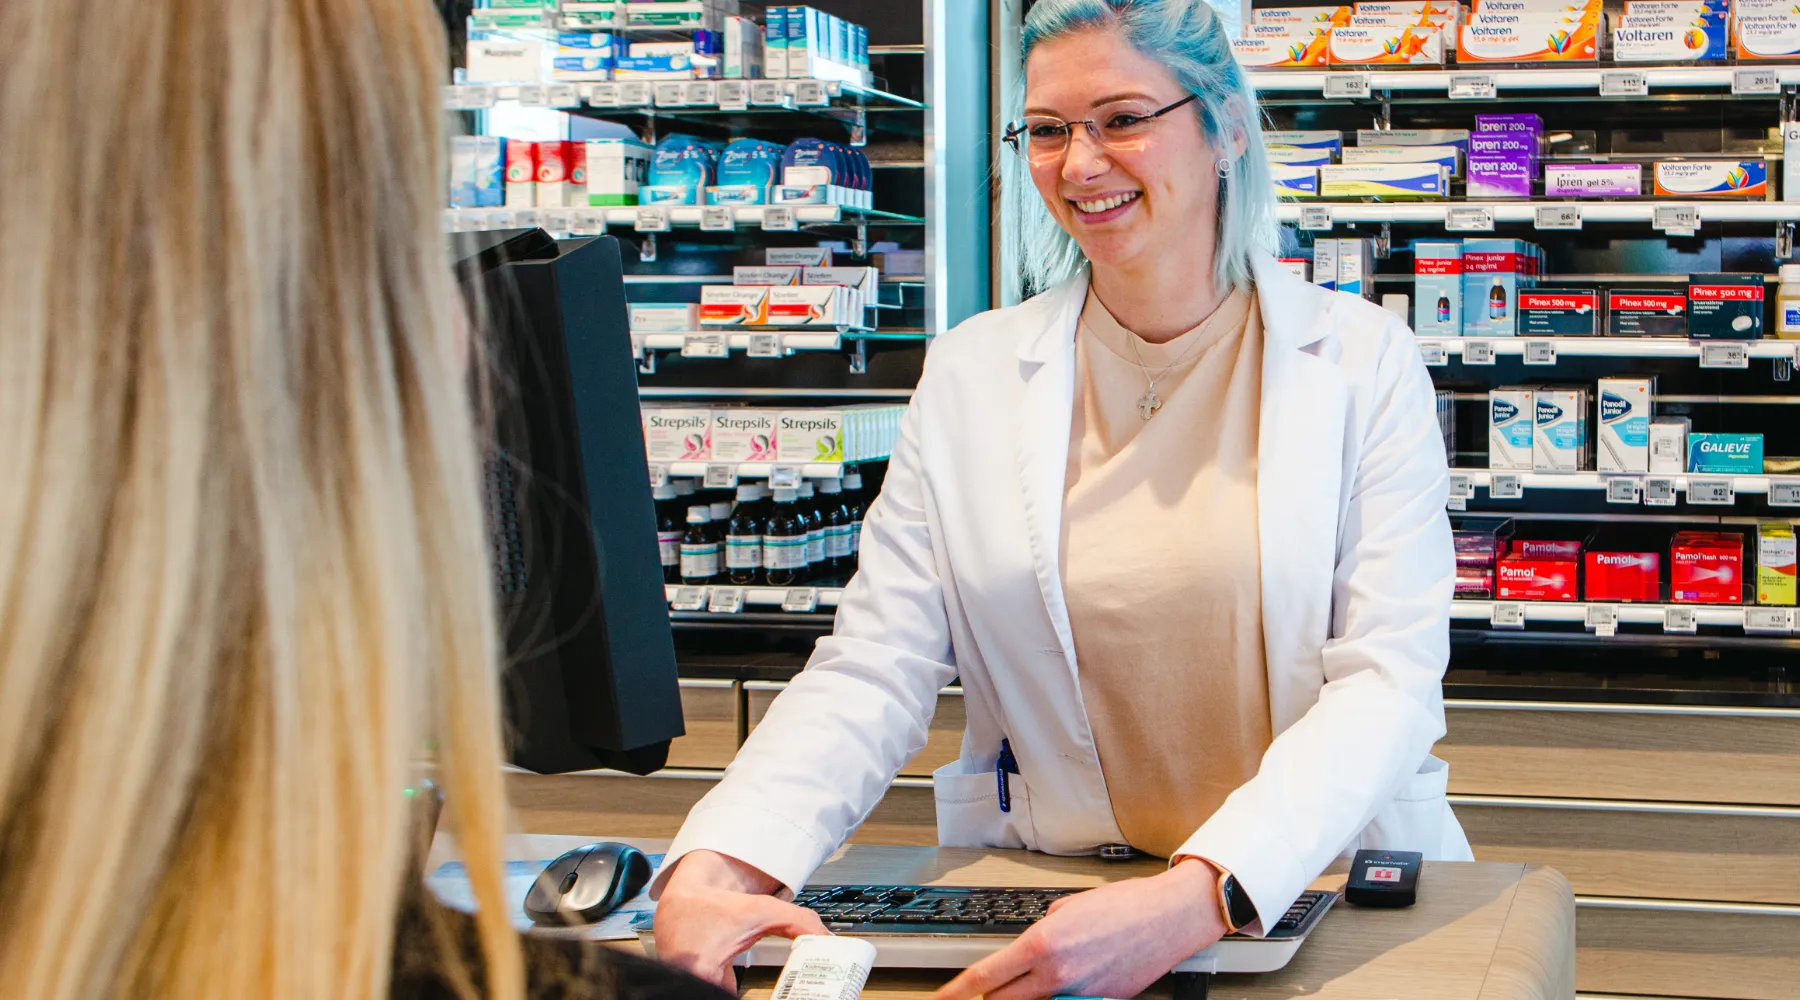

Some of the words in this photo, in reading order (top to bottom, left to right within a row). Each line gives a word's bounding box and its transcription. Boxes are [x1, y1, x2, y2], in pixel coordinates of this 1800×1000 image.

[1359, 4, 1391, 12] Voltaren
[1485, 1, 1524, 10] Voltaren
[1260, 10, 1291, 18] Voltaren
[1479, 14, 1519, 23] Voltaren
[1353, 17, 1386, 25] Voltaren
[1625, 16, 1655, 24] Voltaren
[1471, 26, 1512, 35] Voltaren
[1744, 22, 1776, 30] Voltaren
[1334, 29, 1368, 37] Voltaren
[1616, 30, 1674, 42] Voltaren
[1232, 39, 1265, 47] Voltaren
[1480, 121, 1507, 132] Ipren
[1509, 123, 1525, 131] 200
[1472, 139, 1500, 152] Ipren
[1502, 141, 1520, 149] 200
[1470, 160, 1499, 174] Ipren
[1500, 162, 1518, 171] 200
[1557, 177, 1583, 187] Ipren
[1586, 179, 1600, 187] gel
[1601, 178, 1614, 186] 5%
[1486, 254, 1506, 262] junior
[1475, 262, 1498, 270] mg/ml
[1693, 287, 1717, 297] Pinex
[1719, 290, 1736, 298] 500
[1738, 290, 1753, 298] mg
[1528, 298, 1551, 306] Pinex
[1619, 298, 1642, 306] Pinex
[1642, 299, 1655, 307] 500
[1603, 400, 1627, 409] Panodil
[1602, 407, 1623, 416] Junior
[650, 415, 706, 431] Strepsils
[716, 416, 771, 432] Strepsils
[781, 417, 837, 432] Strepsils
[1700, 441, 1751, 453] GALIEVE
[1523, 542, 1555, 552] Pamol
[1597, 554, 1631, 565] Pamol
[1675, 552, 1701, 560] Pamol
[1500, 566, 1534, 577] Pamol
